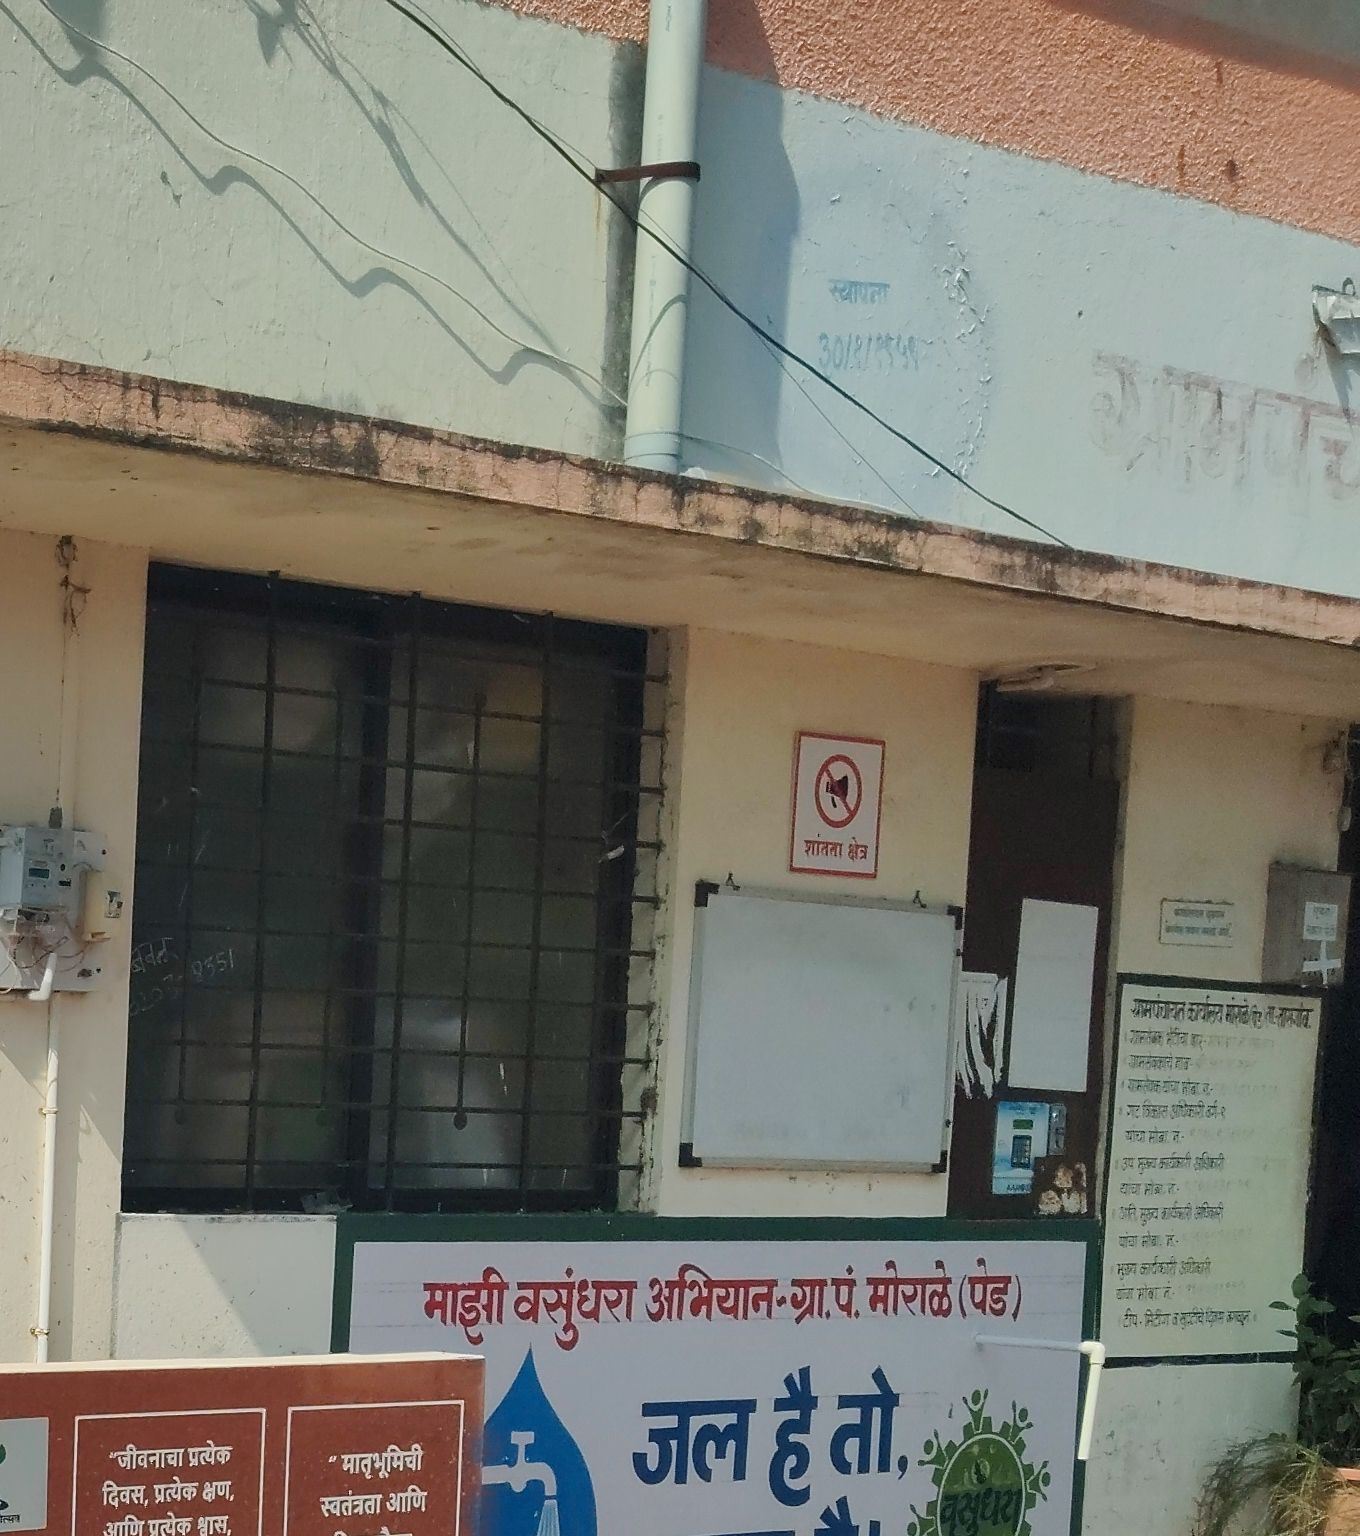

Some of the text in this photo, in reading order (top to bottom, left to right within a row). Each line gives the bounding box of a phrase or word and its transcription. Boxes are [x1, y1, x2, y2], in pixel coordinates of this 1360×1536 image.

[804, 833, 868, 861] शांतता क्षेत्र
[422, 1265, 510, 1346] माझी
[513, 1265, 638, 1351] वसुंधरा
[866, 1259, 953, 1319] मोराळे
[958, 1257, 1022, 1322] (पेड)
[632, 1364, 909, 1507] जल है तो,
[187, 1440, 233, 1467] प्रत्येक
[341, 1443, 423, 1479] मातृभूमिची
[102, 1475, 235, 1509] दिवस, प्रत्येक क्षण,
[319, 1484, 428, 1517] स्वतंत्रता आणि
